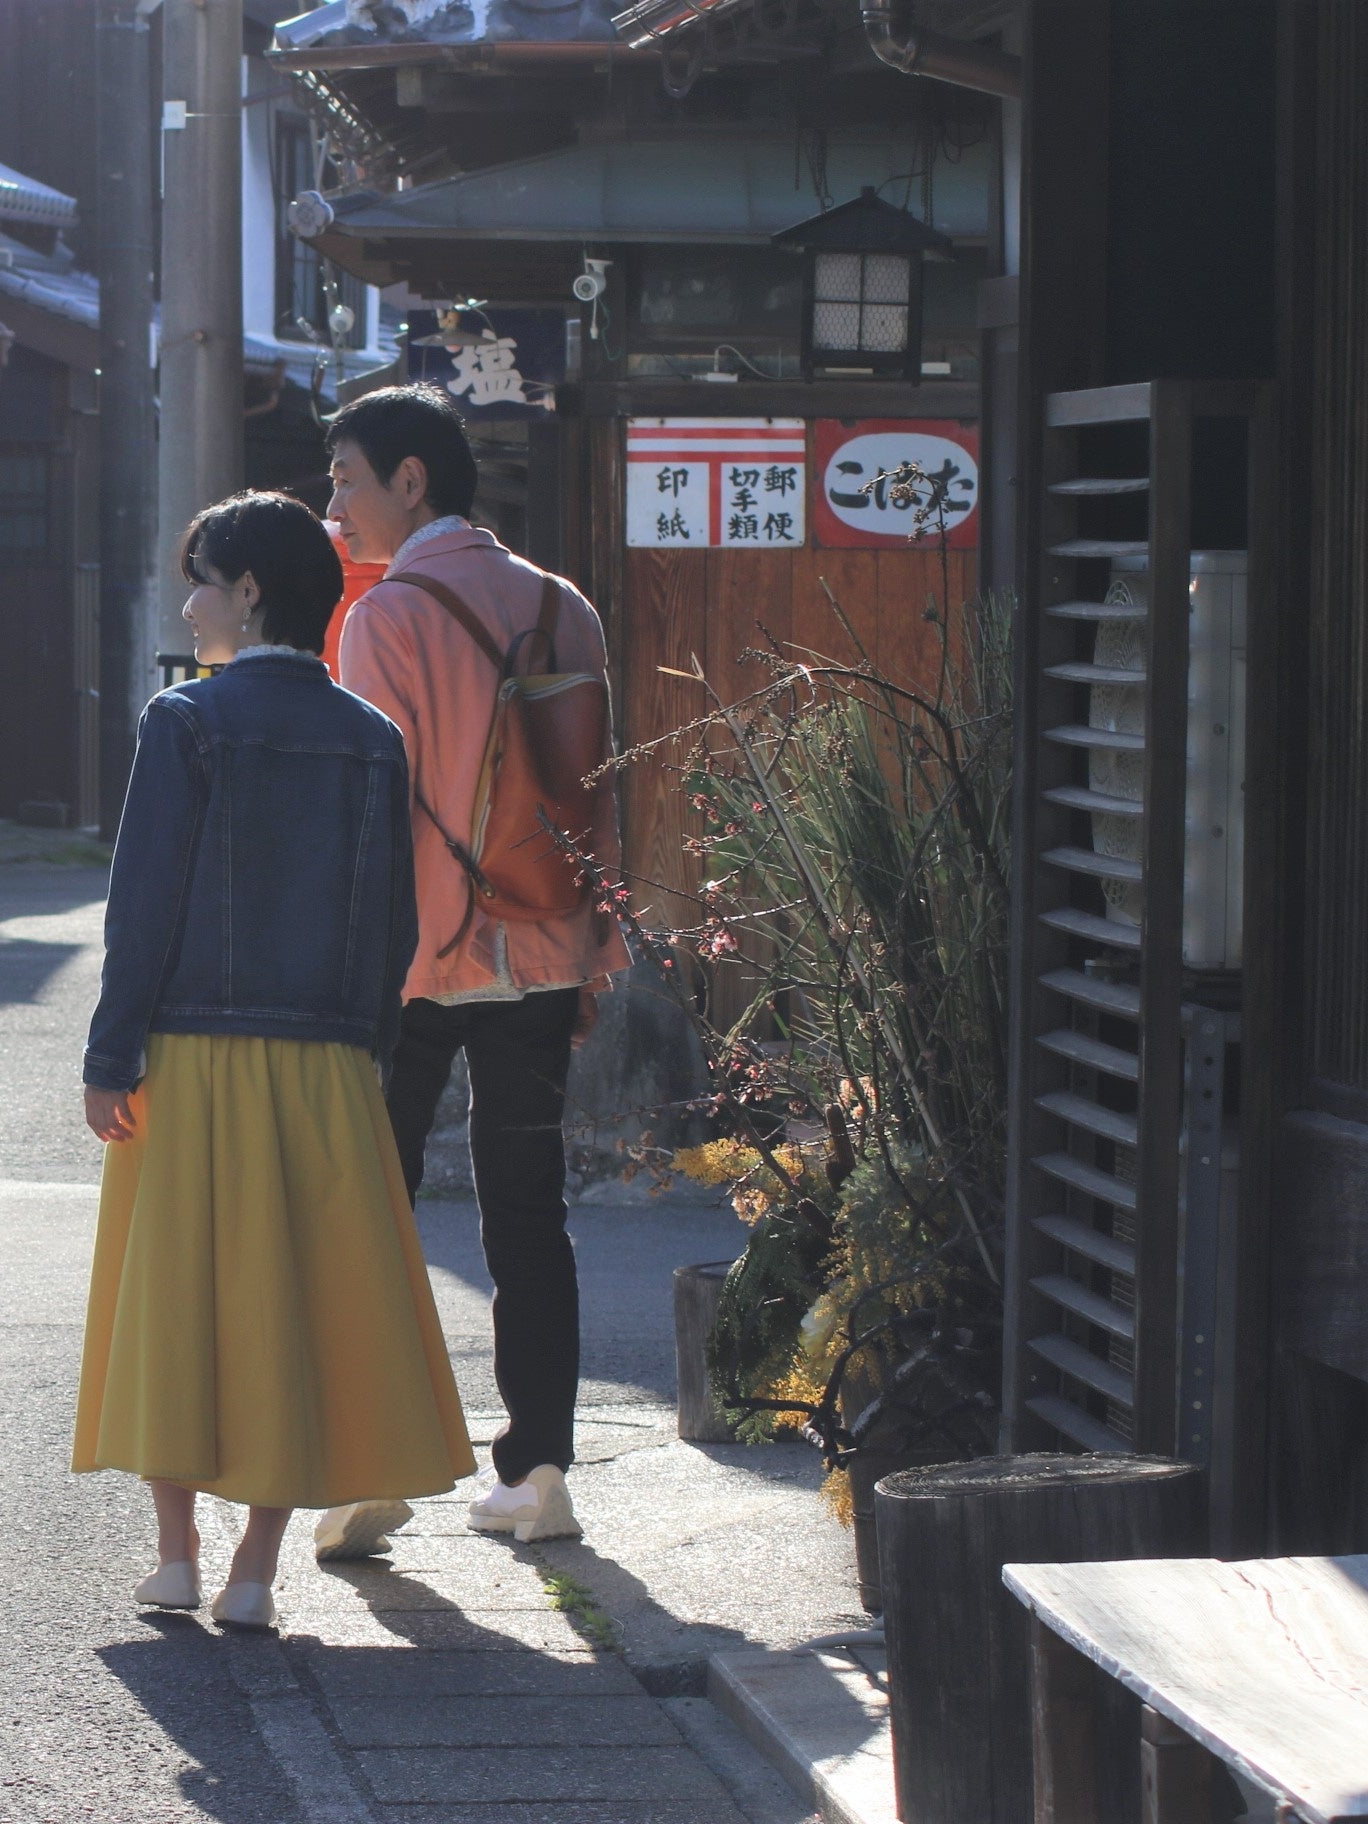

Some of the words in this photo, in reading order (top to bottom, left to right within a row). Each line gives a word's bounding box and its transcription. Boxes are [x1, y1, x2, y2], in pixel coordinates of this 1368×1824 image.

[656, 466, 690, 541] 印紙
[728, 466, 760, 540] 切手類
[763, 465, 798, 541] 郵便
